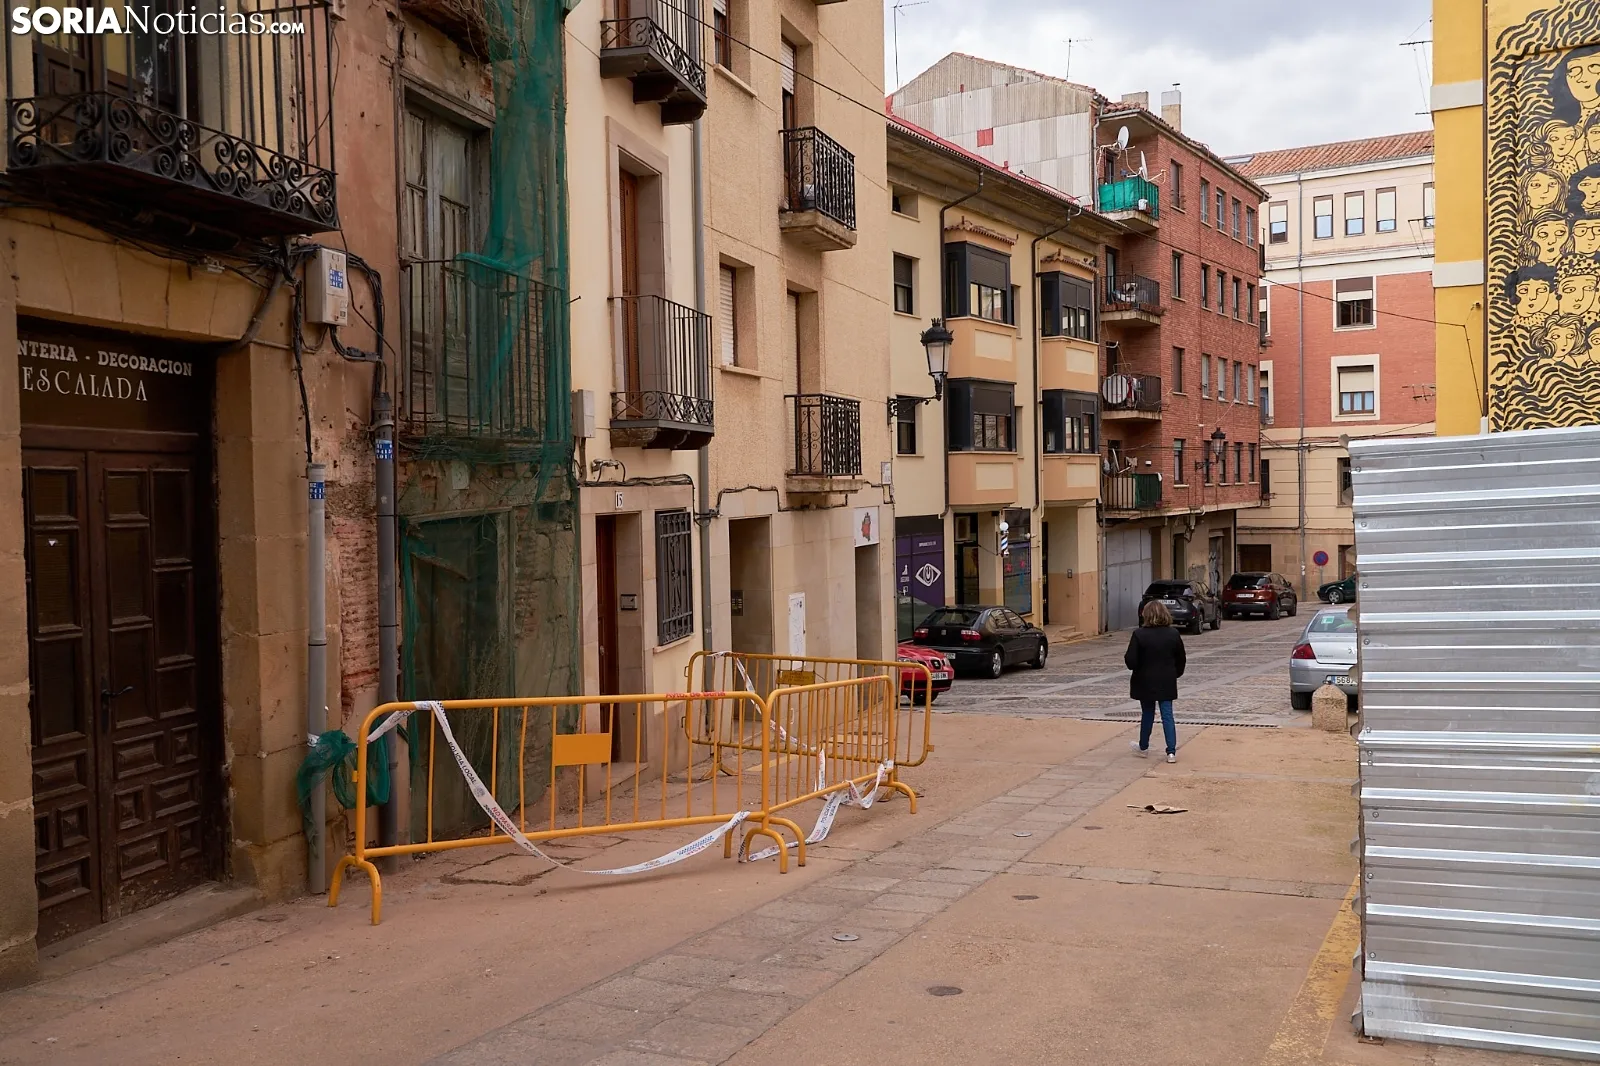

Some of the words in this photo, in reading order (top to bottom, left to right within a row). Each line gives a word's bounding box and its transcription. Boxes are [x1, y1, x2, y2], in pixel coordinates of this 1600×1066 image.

[98, 351, 192, 377] DECORACION
[22, 366, 148, 401] ESCALADA
[616, 493, 623, 507] 15
[463, 764, 477, 784] LOCAL
[491, 806, 500, 817] NO
